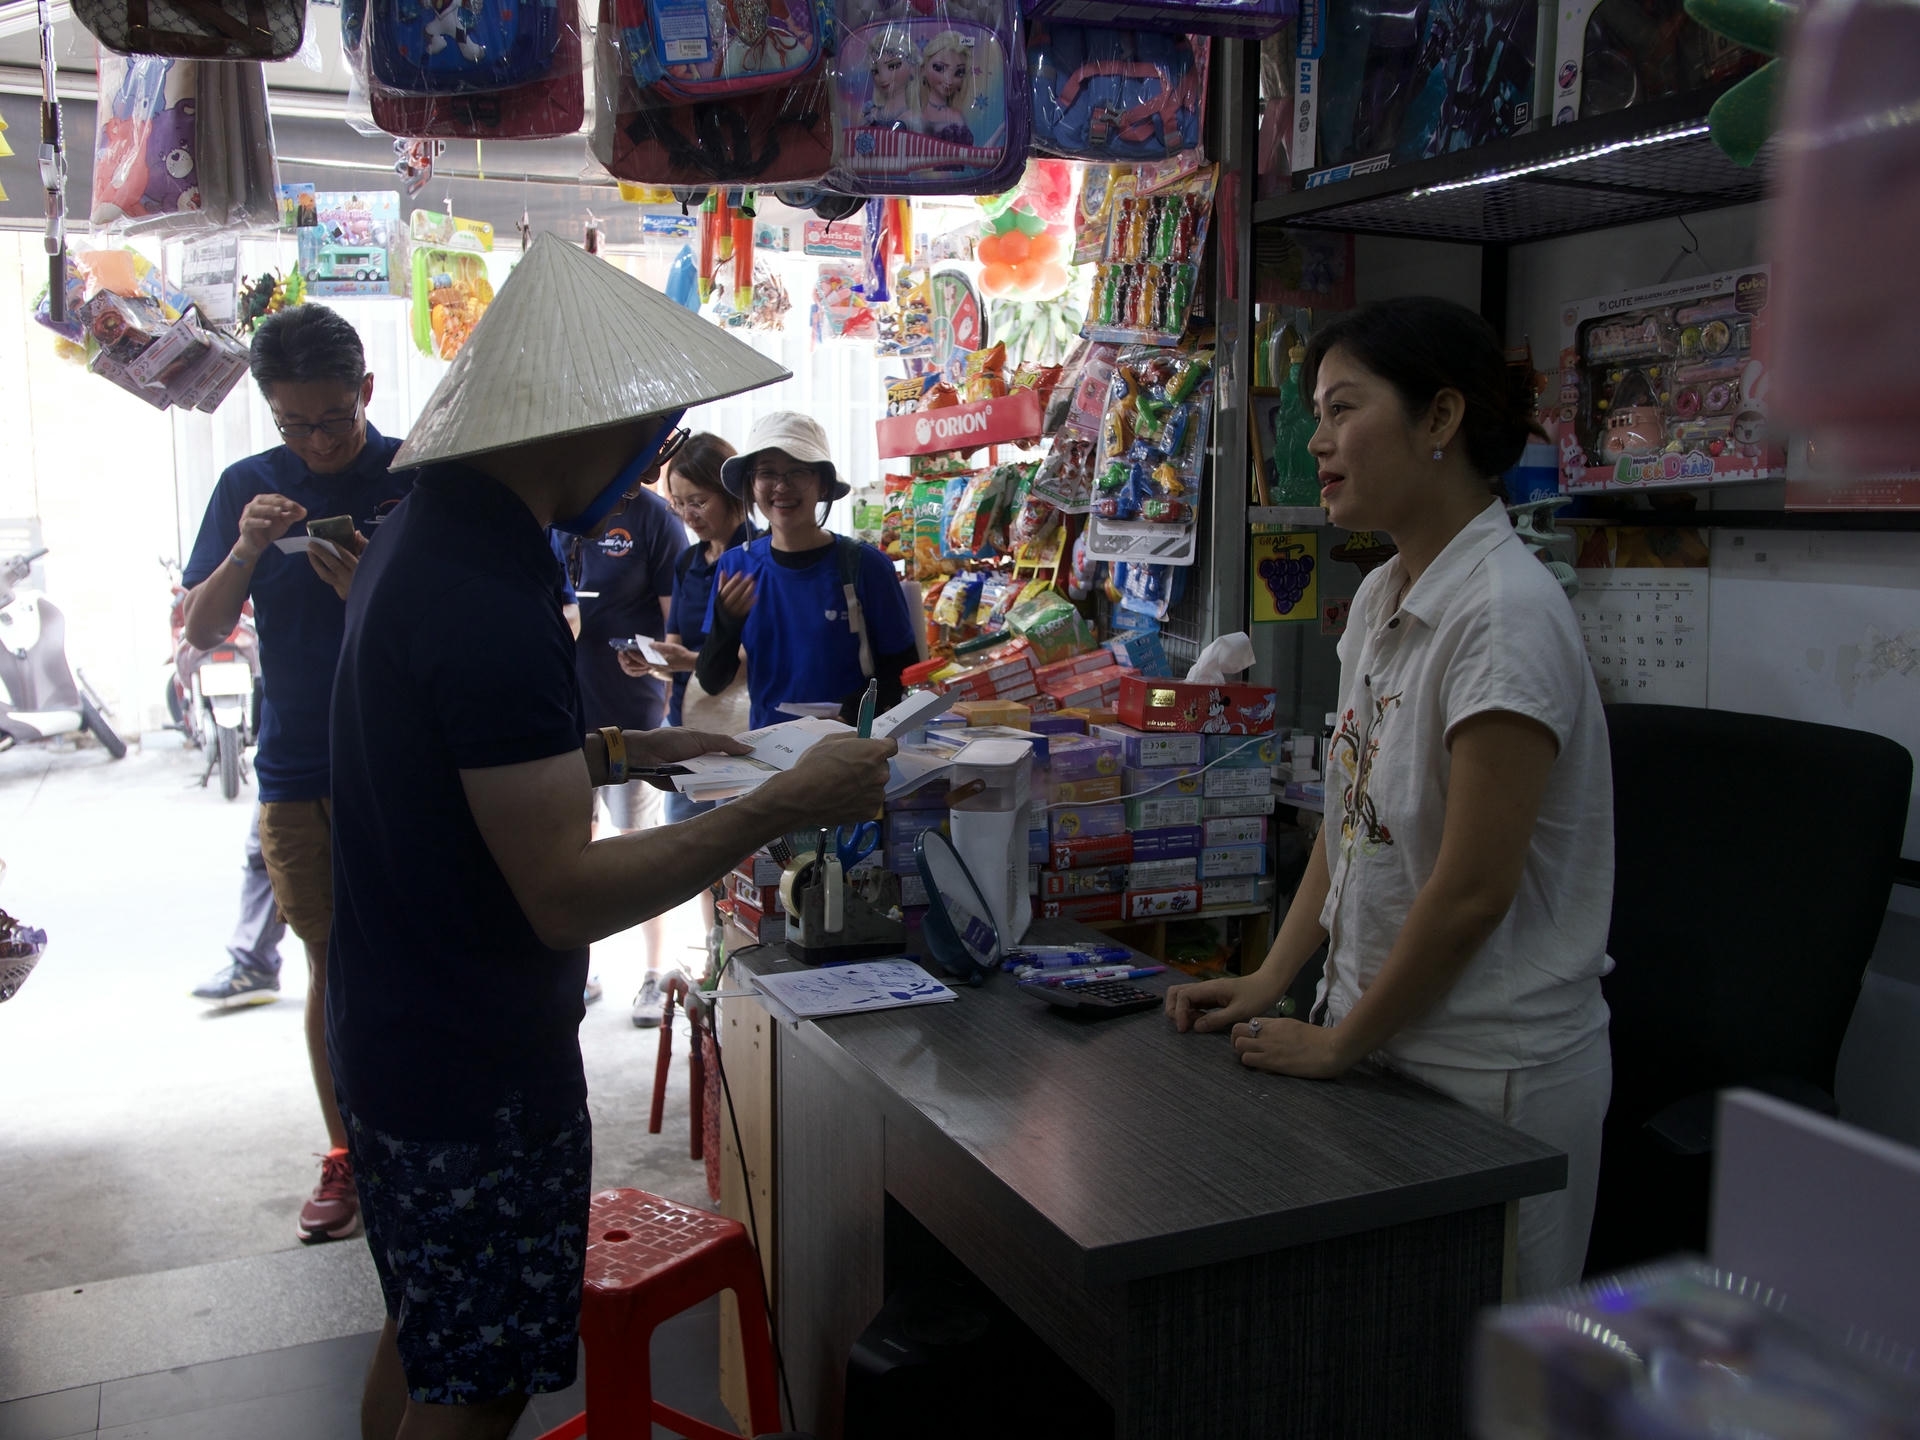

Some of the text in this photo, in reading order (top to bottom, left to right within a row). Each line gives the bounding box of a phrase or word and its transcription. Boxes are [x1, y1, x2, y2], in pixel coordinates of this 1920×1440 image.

[1300, 62, 1311, 94] CAR
[1738, 278, 1767, 292] cute
[1608, 298, 1633, 310] CUTE
[935, 411, 987, 438] ORION
[1260, 536, 1293, 545] GRAPE
[1674, 615, 1683, 623] 10
